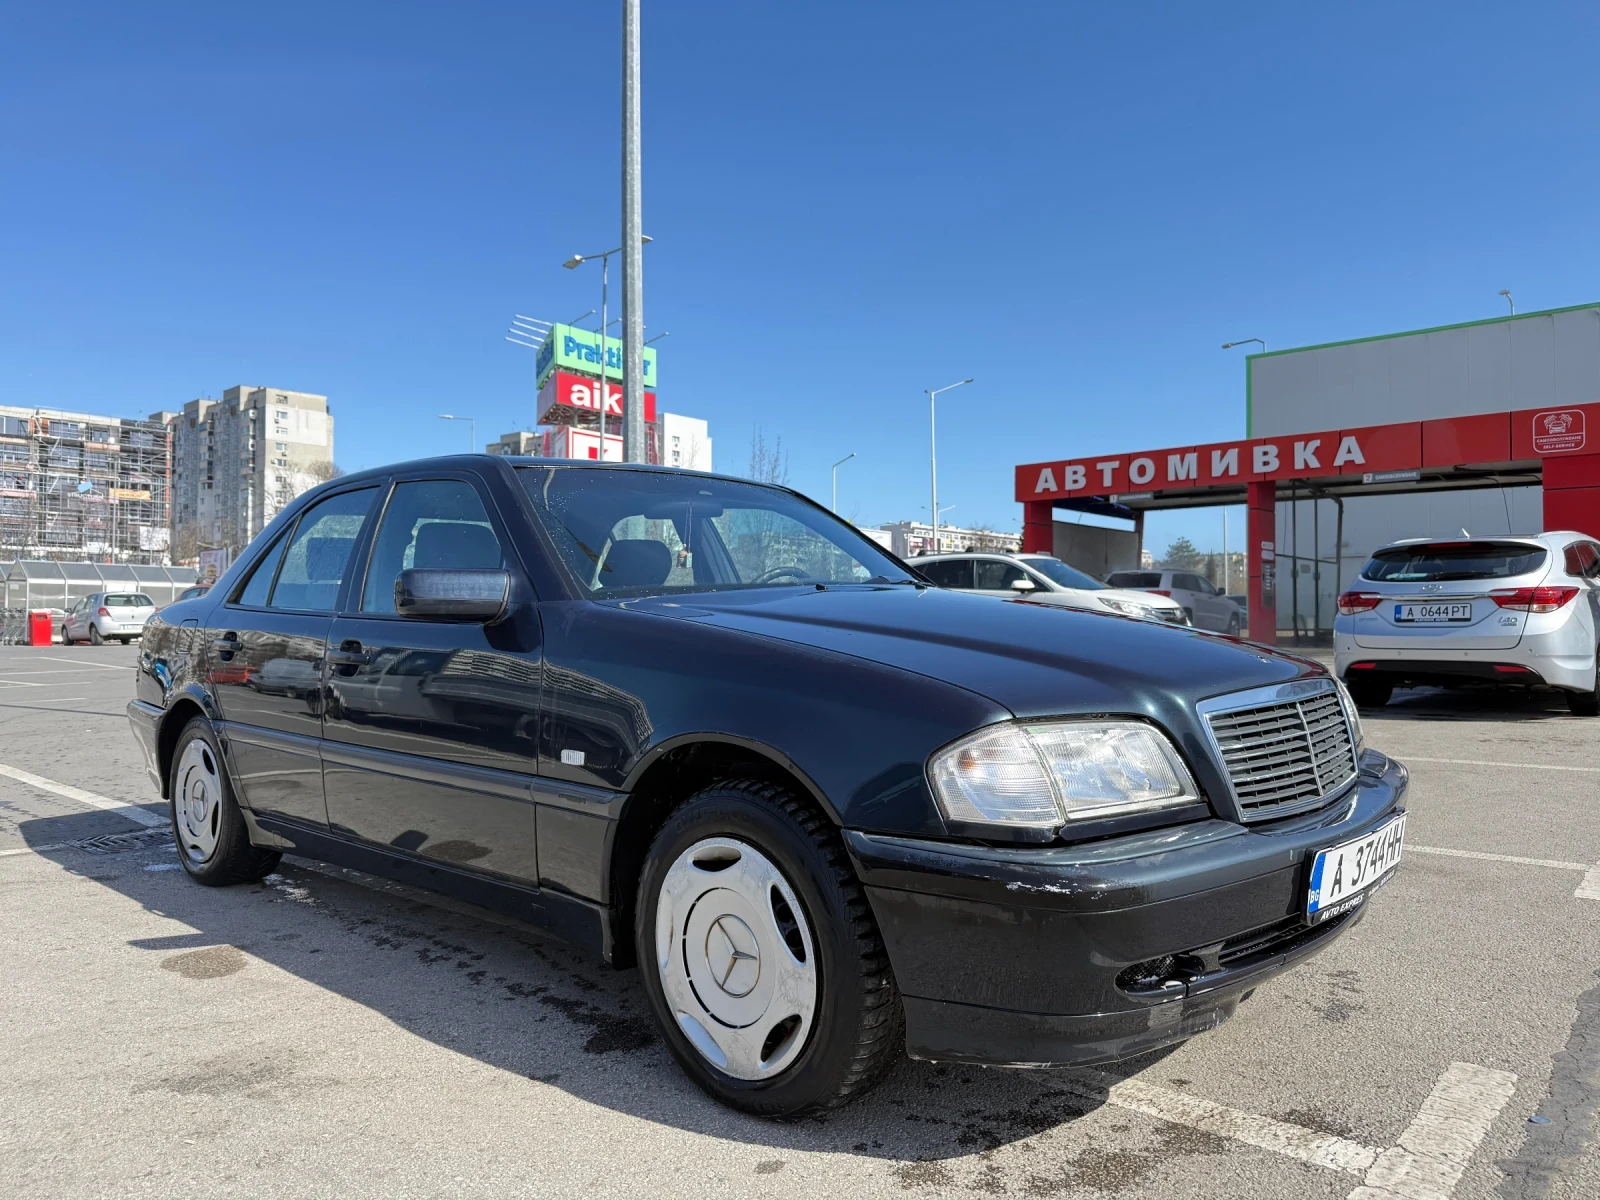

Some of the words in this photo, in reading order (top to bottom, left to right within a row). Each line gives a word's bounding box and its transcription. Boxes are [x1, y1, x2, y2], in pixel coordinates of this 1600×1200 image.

[564, 335, 650, 376] Praktir
[1034, 435, 1366, 493] АВТОМИВКА
[1407, 607, 1413, 617] A
[1330, 854, 1343, 898] A
[1310, 889, 1319, 903] BG
[1321, 907, 1340, 921] AVTO
